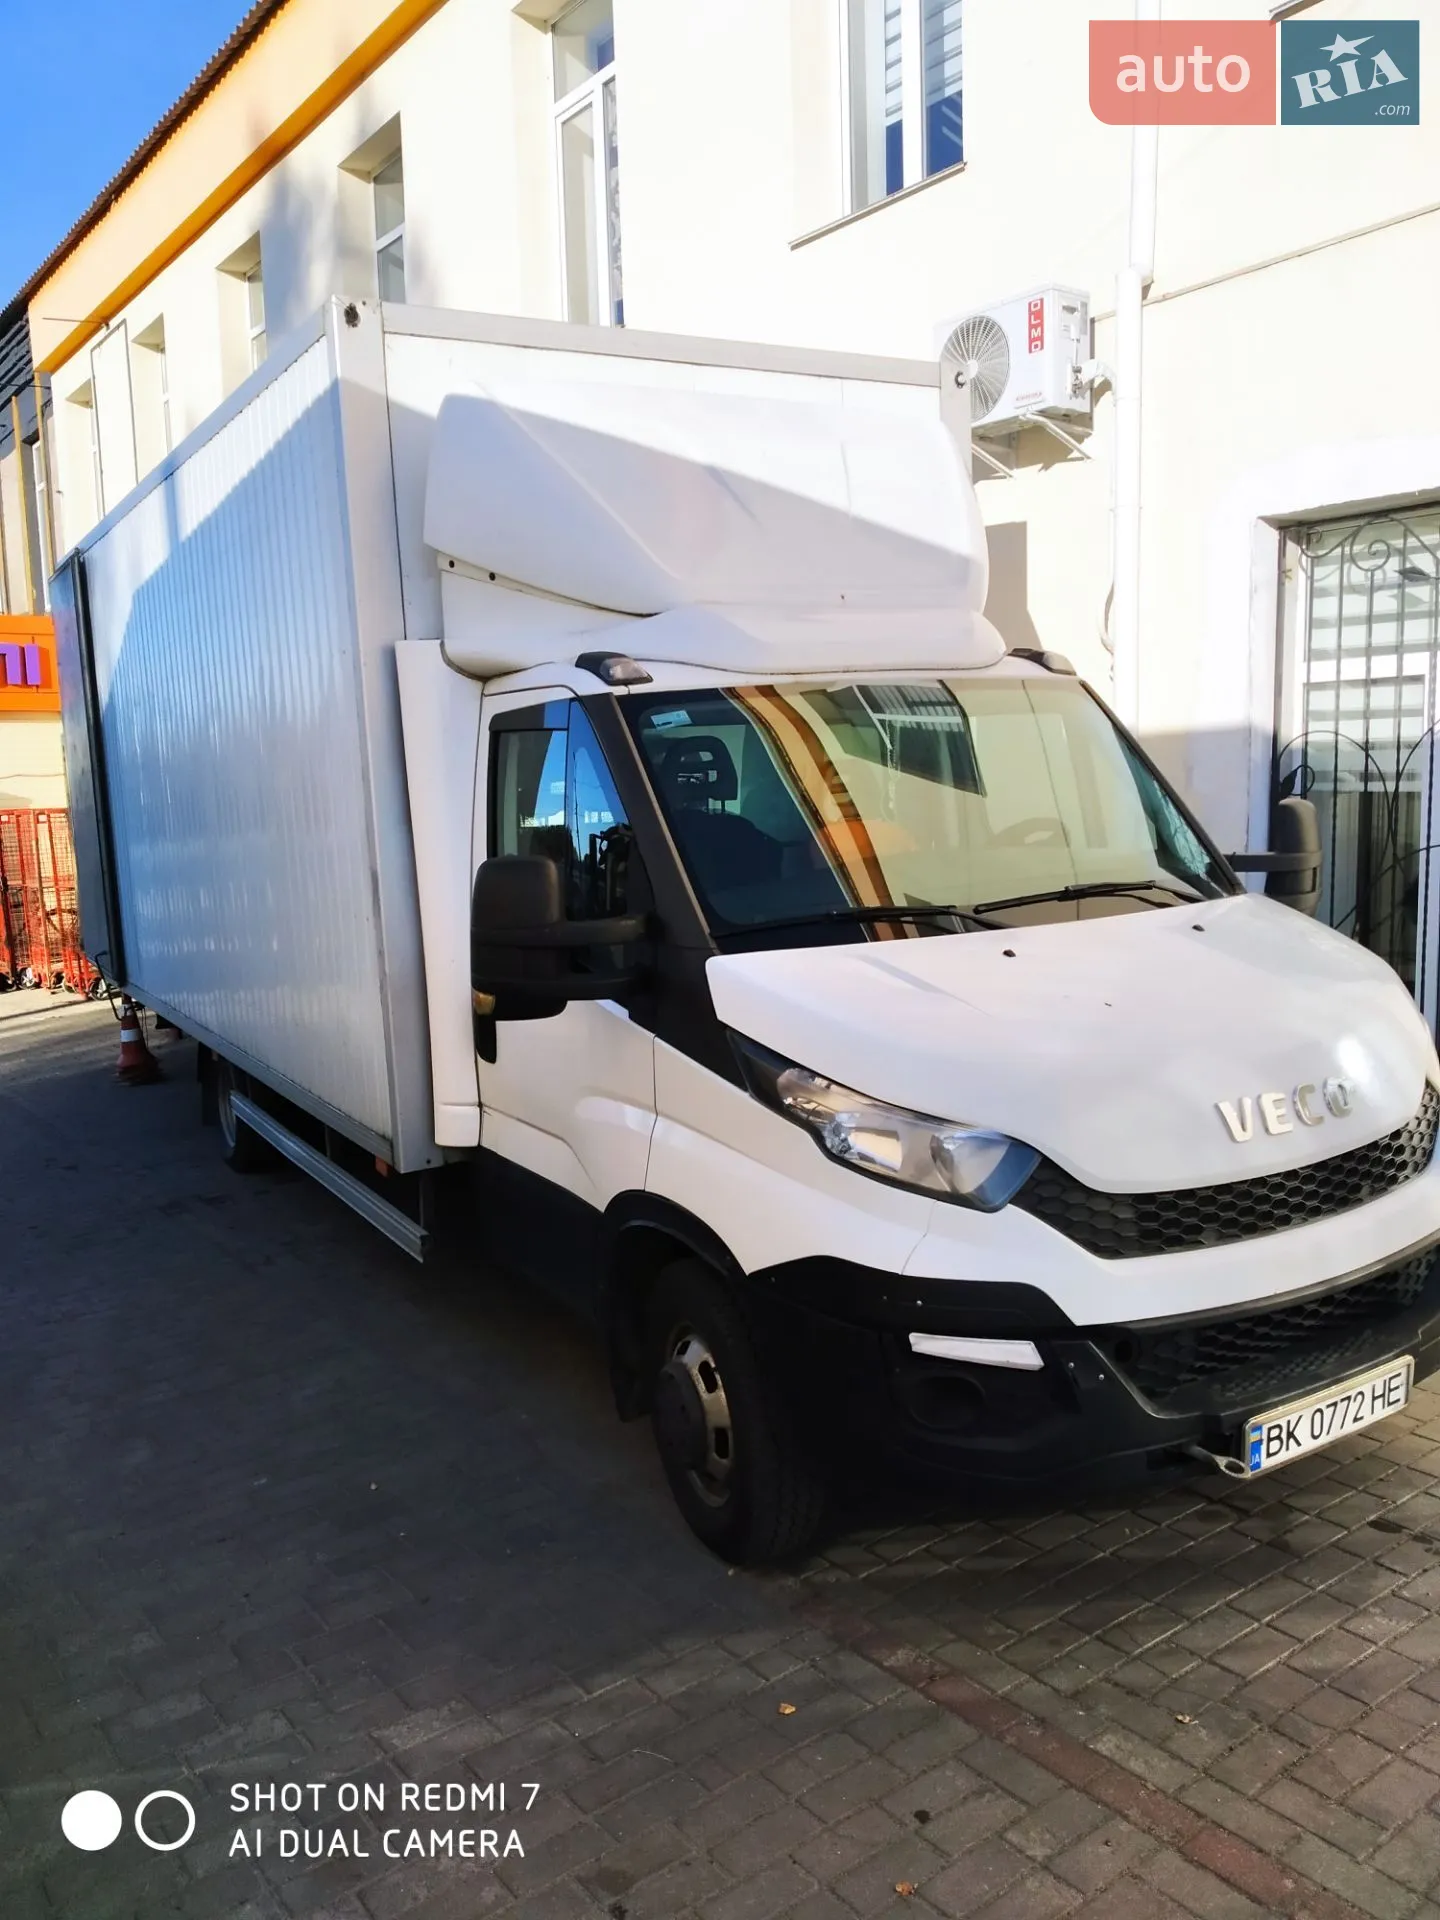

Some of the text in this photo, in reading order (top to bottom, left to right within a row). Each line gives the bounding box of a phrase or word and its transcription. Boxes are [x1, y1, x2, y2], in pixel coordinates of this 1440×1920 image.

[1030, 299, 1042, 352] OLMO
[1214, 1077, 1354, 1143] VECO
[1266, 1372, 1402, 1459] BK 0772 HE
